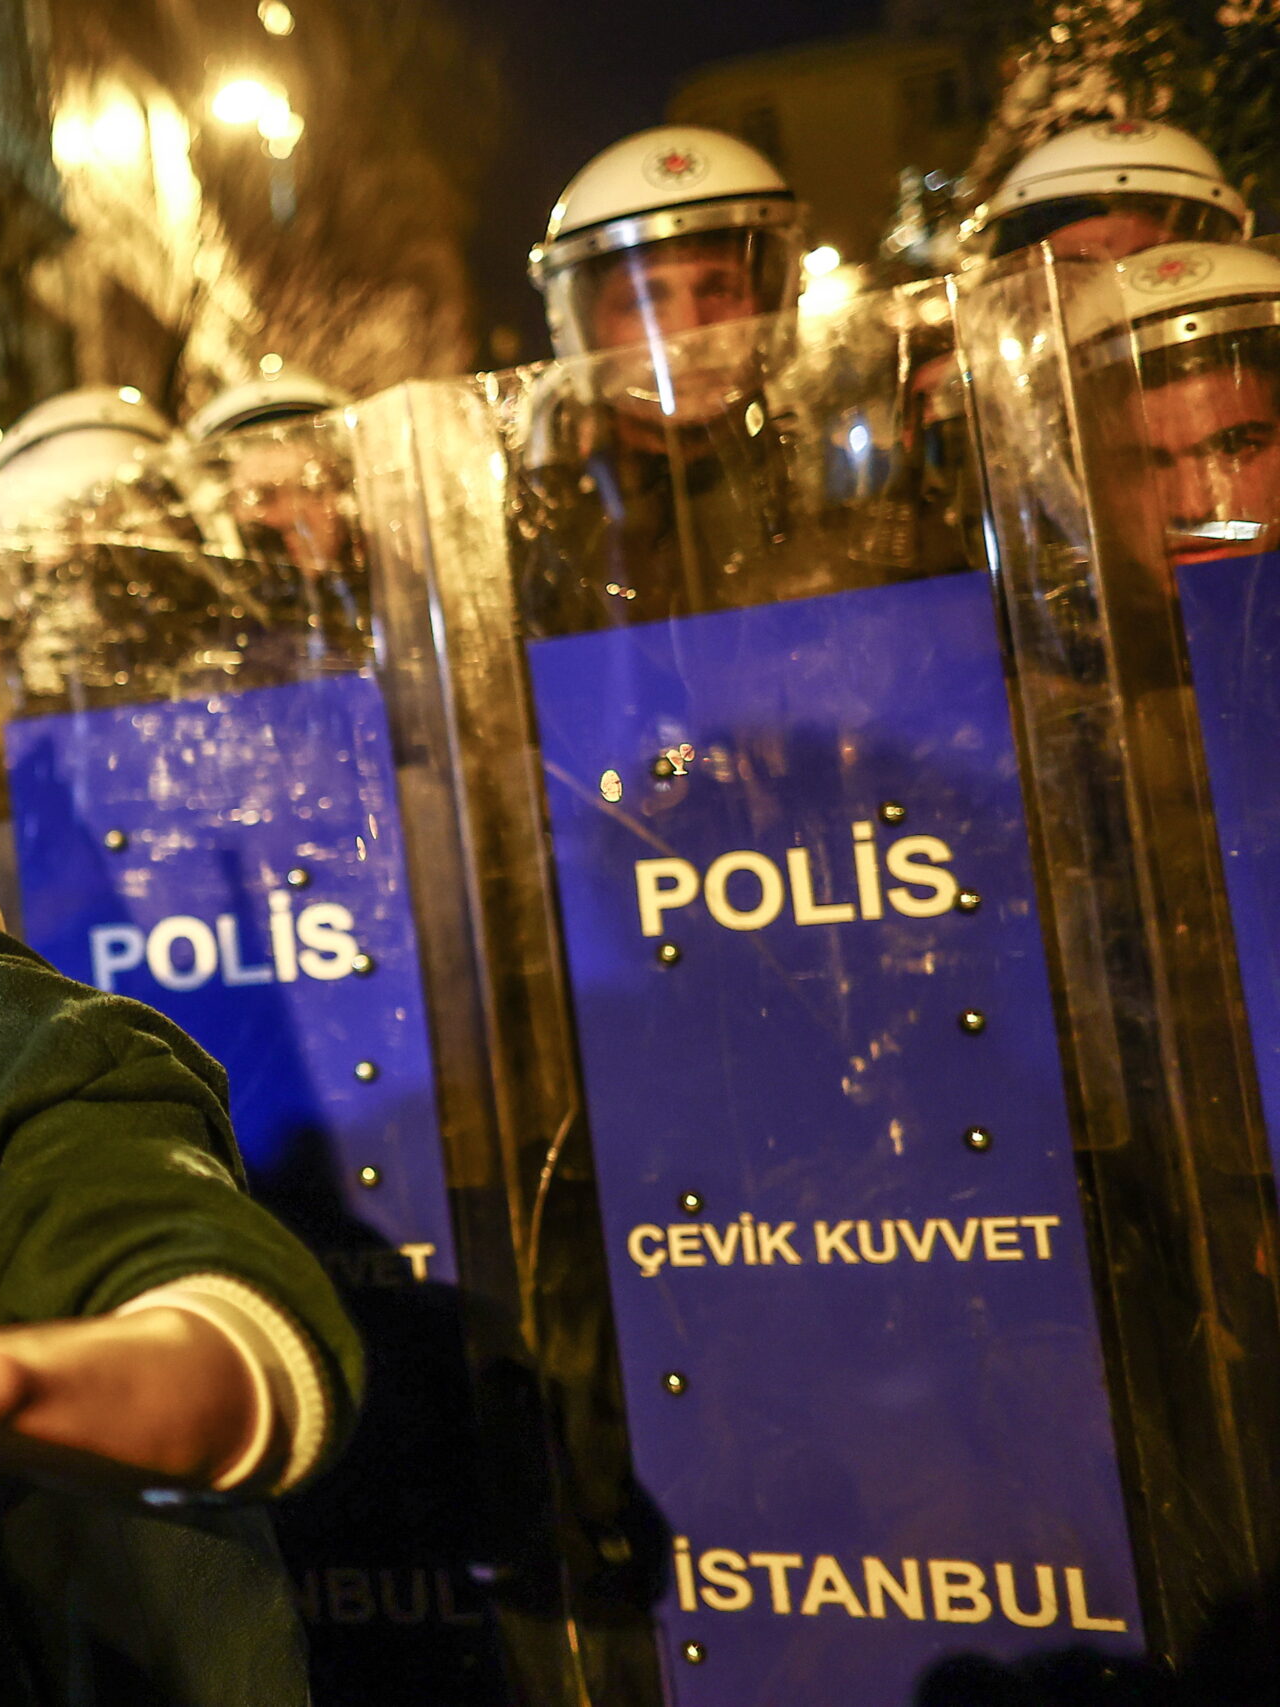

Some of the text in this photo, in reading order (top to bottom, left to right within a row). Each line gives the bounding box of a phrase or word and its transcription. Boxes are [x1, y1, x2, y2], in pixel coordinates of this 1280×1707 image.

[634, 820, 959, 938] POLİS
[89, 889, 361, 993] POLİS
[626, 1212, 1060, 1277] ÇEVİK KUVVET
[672, 1535, 1128, 1633] İSTANBUL
